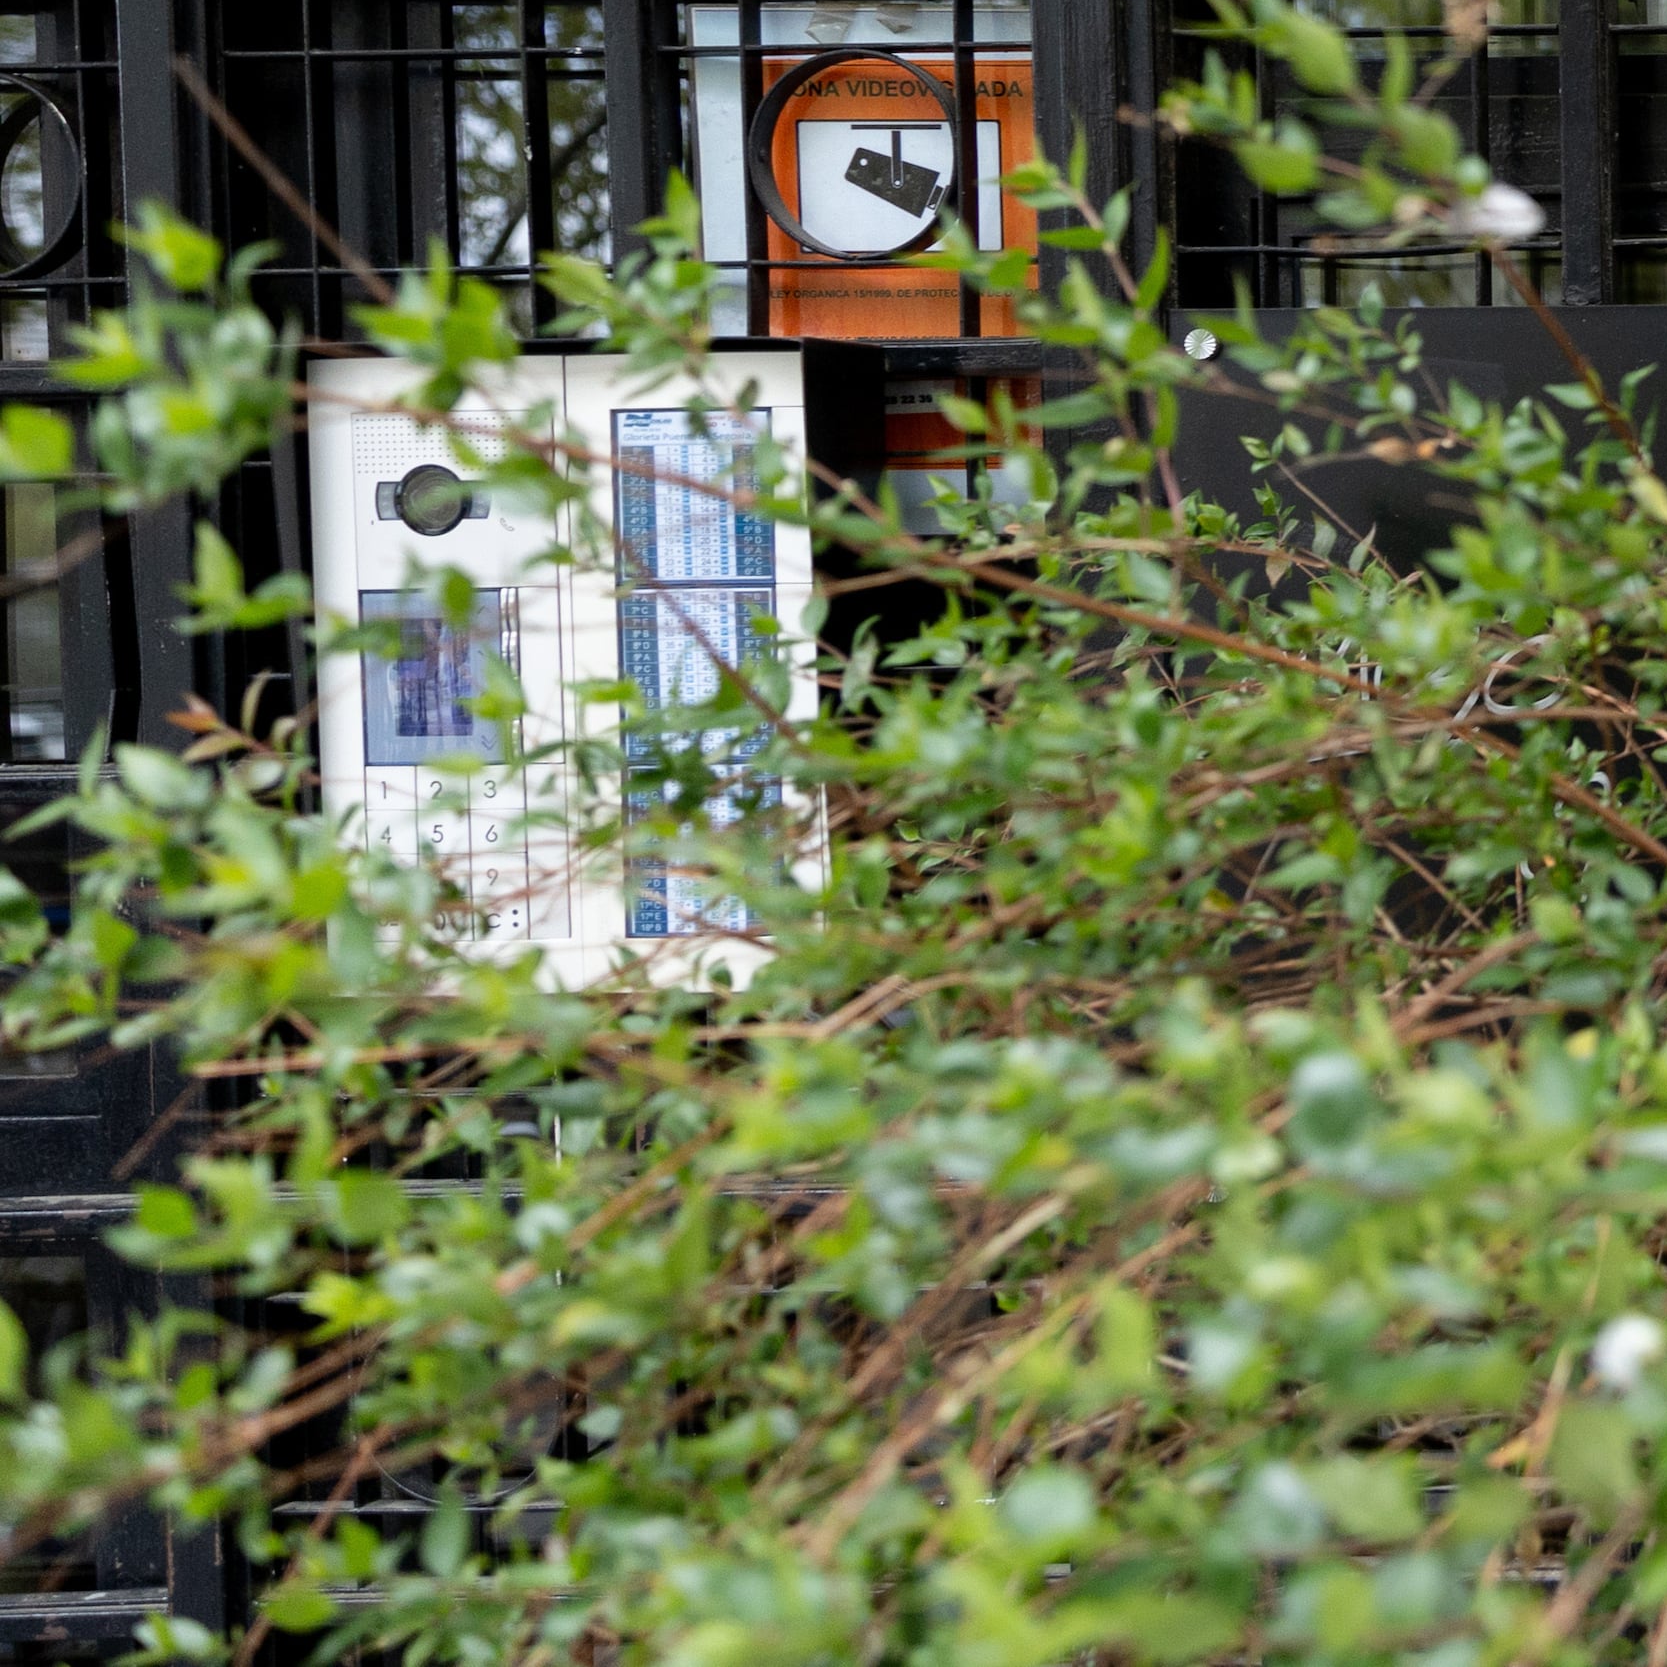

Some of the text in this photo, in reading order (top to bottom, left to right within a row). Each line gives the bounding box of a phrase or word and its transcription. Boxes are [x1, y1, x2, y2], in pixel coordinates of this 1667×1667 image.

[793, 80, 840, 97] ONA
[430, 781, 443, 799] 2
[483, 780, 497, 799] 3
[380, 824, 498, 844] 4 5 6
[486, 868, 498, 886] 9
